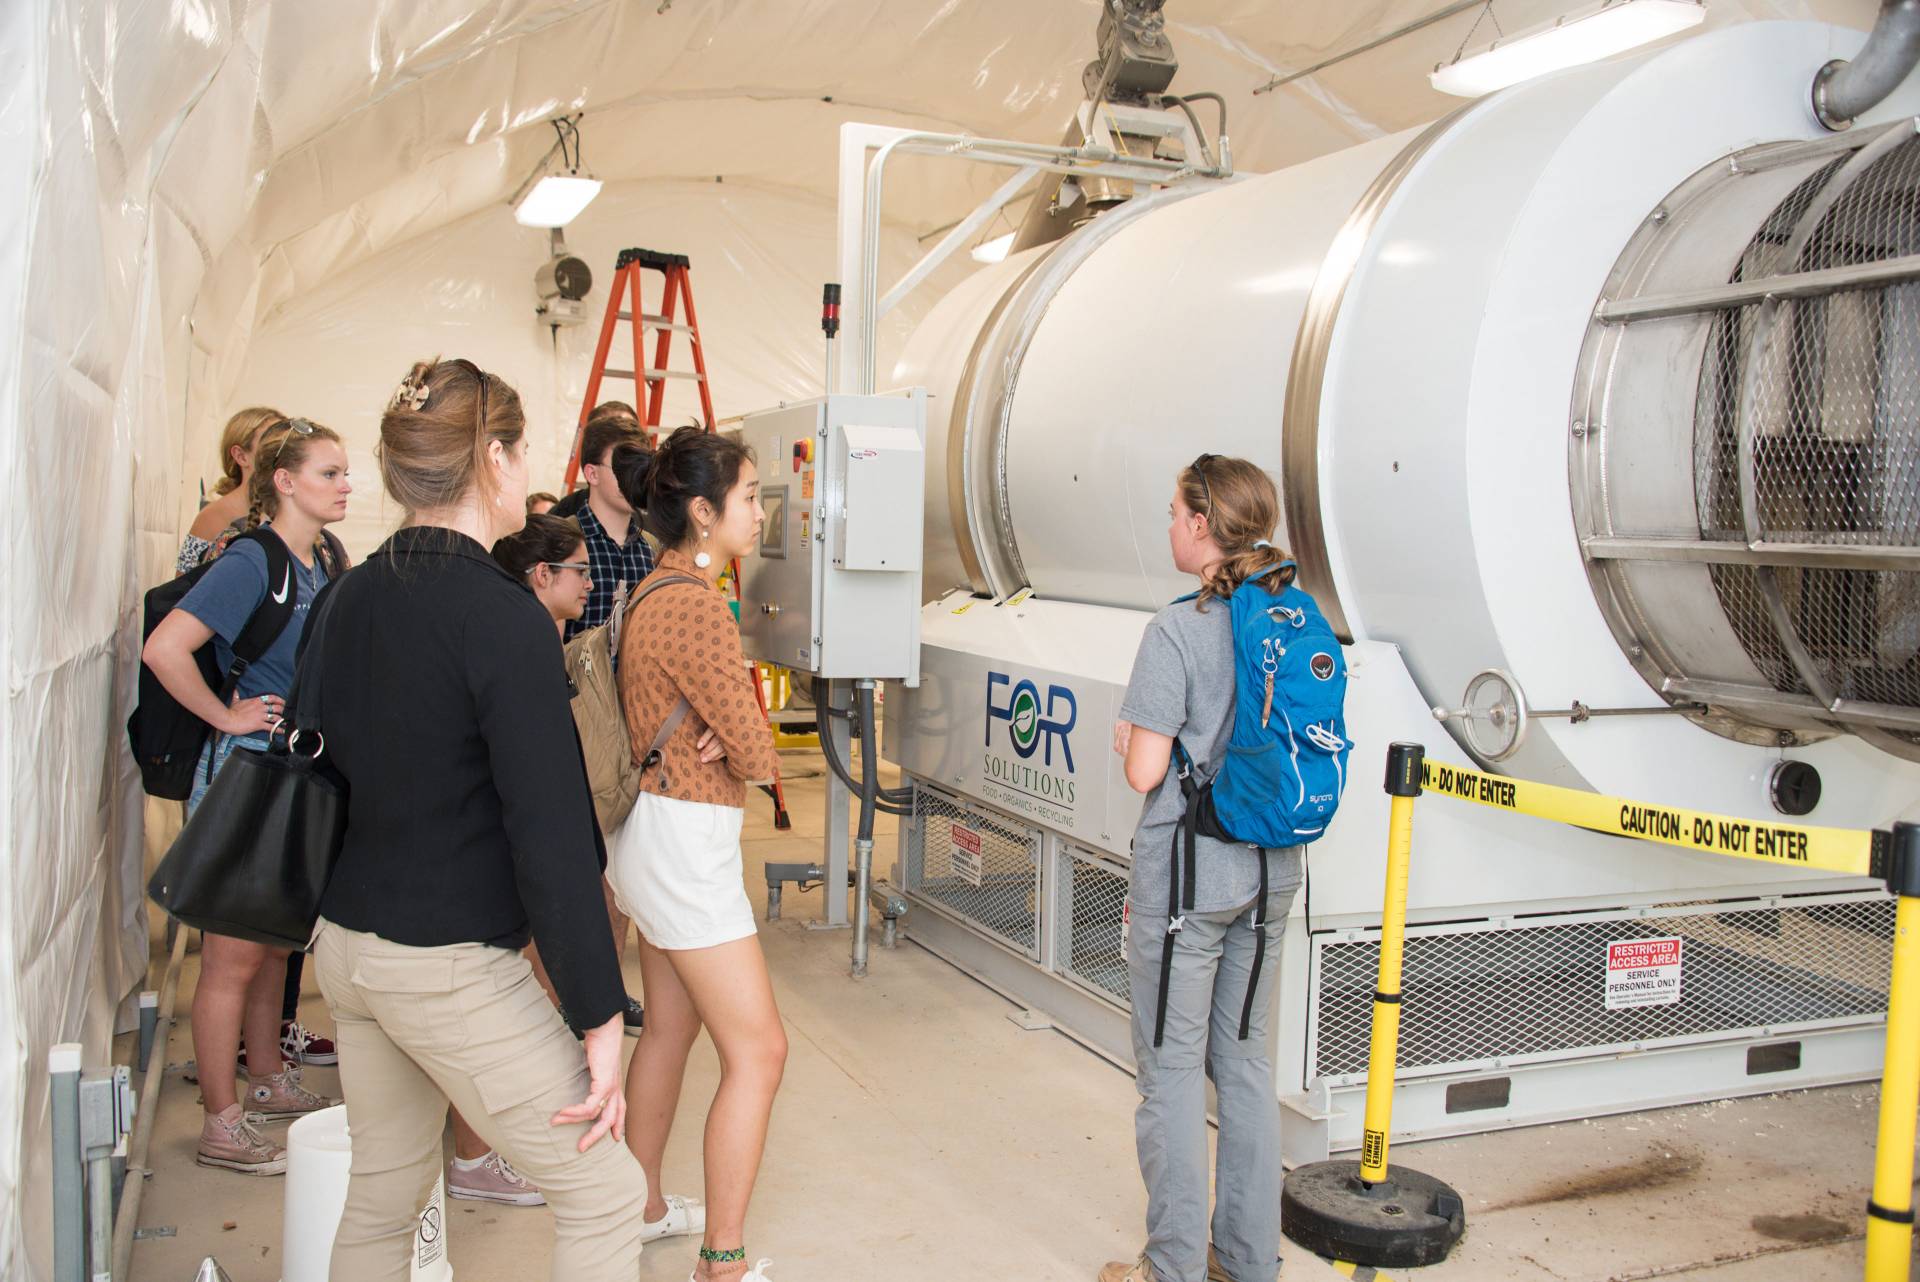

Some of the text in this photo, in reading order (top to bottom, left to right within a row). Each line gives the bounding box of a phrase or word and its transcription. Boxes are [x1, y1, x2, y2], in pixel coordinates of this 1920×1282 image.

[985, 671, 1077, 774] FOR
[984, 754, 1075, 804] SOLUTIONS
[1439, 768, 1453, 792] DO
[1456, 772, 1477, 798] NOT
[1480, 778, 1516, 807] ENTER
[983, 785, 1074, 828] FOOD ORGANICS RECYCLING
[1620, 804, 1680, 841] CAUTION
[1693, 818, 1714, 847] DO
[1719, 822, 1750, 855] NOT
[1756, 827, 1808, 861] ENTER
[1610, 953, 1678, 969] ACCESS AREA
[1615, 942, 1674, 957] RESTRICTED
[1610, 978, 1676, 992] PERSONNEL ONLY
[1627, 969, 1660, 980] SERVICE
